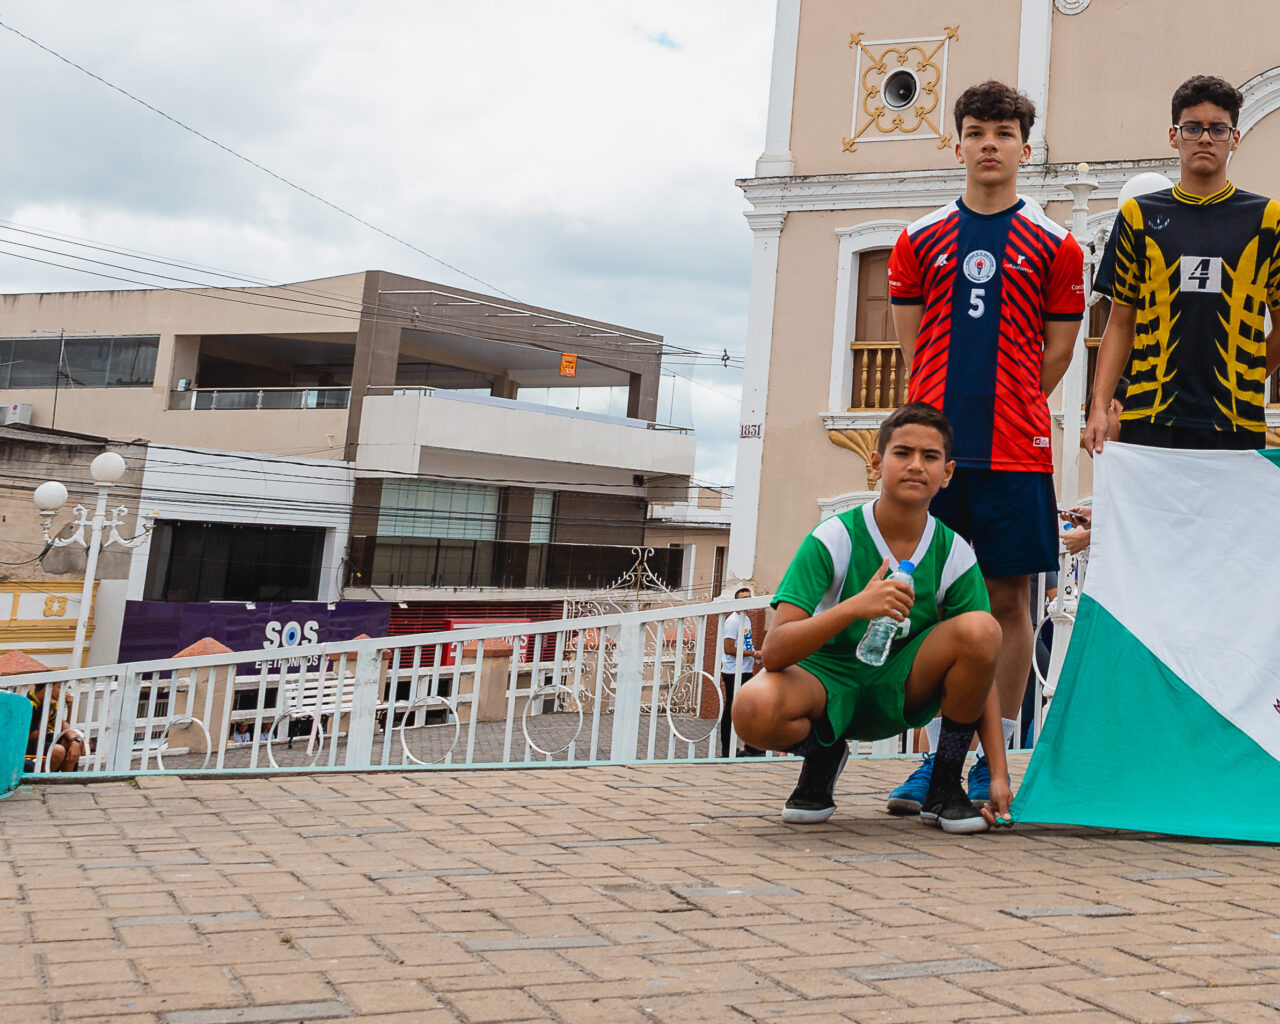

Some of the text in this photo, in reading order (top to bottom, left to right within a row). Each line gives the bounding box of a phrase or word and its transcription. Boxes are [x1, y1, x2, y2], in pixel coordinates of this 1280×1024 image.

[1188, 259, 1210, 289] 4
[968, 288, 985, 318] 5
[263, 620, 319, 649] SOS
